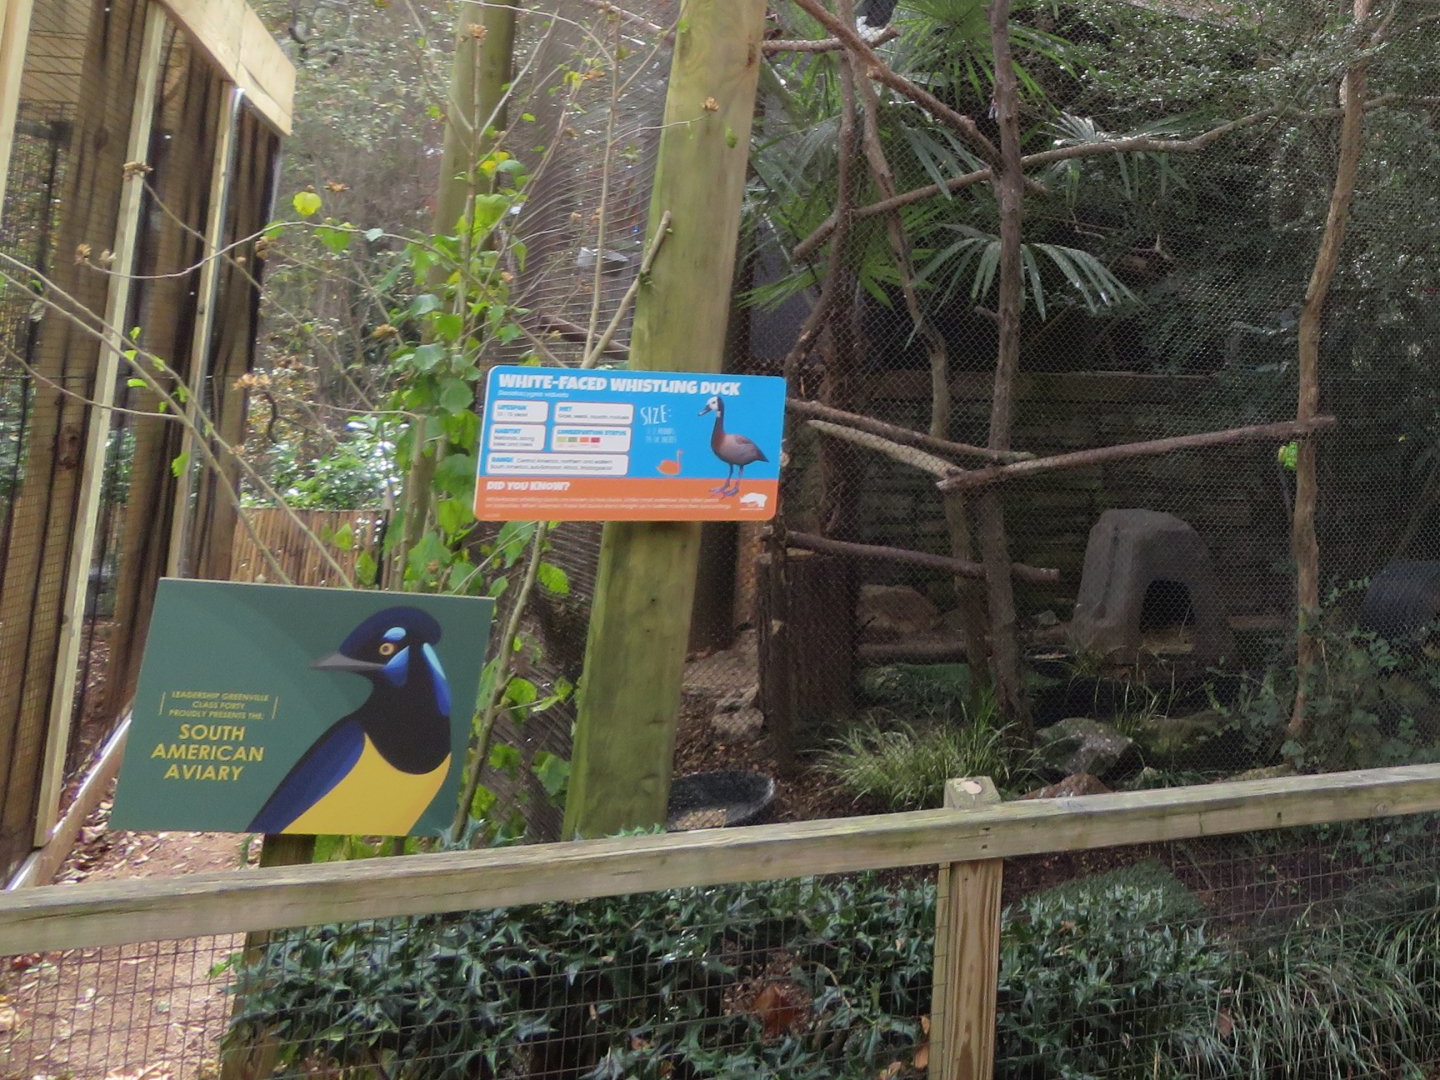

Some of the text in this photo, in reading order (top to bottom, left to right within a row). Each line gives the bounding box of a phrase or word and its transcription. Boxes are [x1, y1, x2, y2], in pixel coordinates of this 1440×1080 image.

[498, 374, 741, 396] WHITE-FACED WHISTLING DUCK
[640, 404, 672, 425] SIZE:
[486, 481, 571, 491] DID YOU KNOW?
[171, 691, 270, 701] LEADERSHIP GREENVILLE
[192, 701, 218, 709] CLASS
[168, 709, 207, 718] PROUDLY
[208, 711, 247, 719] PRESENTS
[178, 723, 245, 741] SOUTH
[150, 743, 265, 761] AMERICAN
[163, 763, 244, 781] AVIARY
